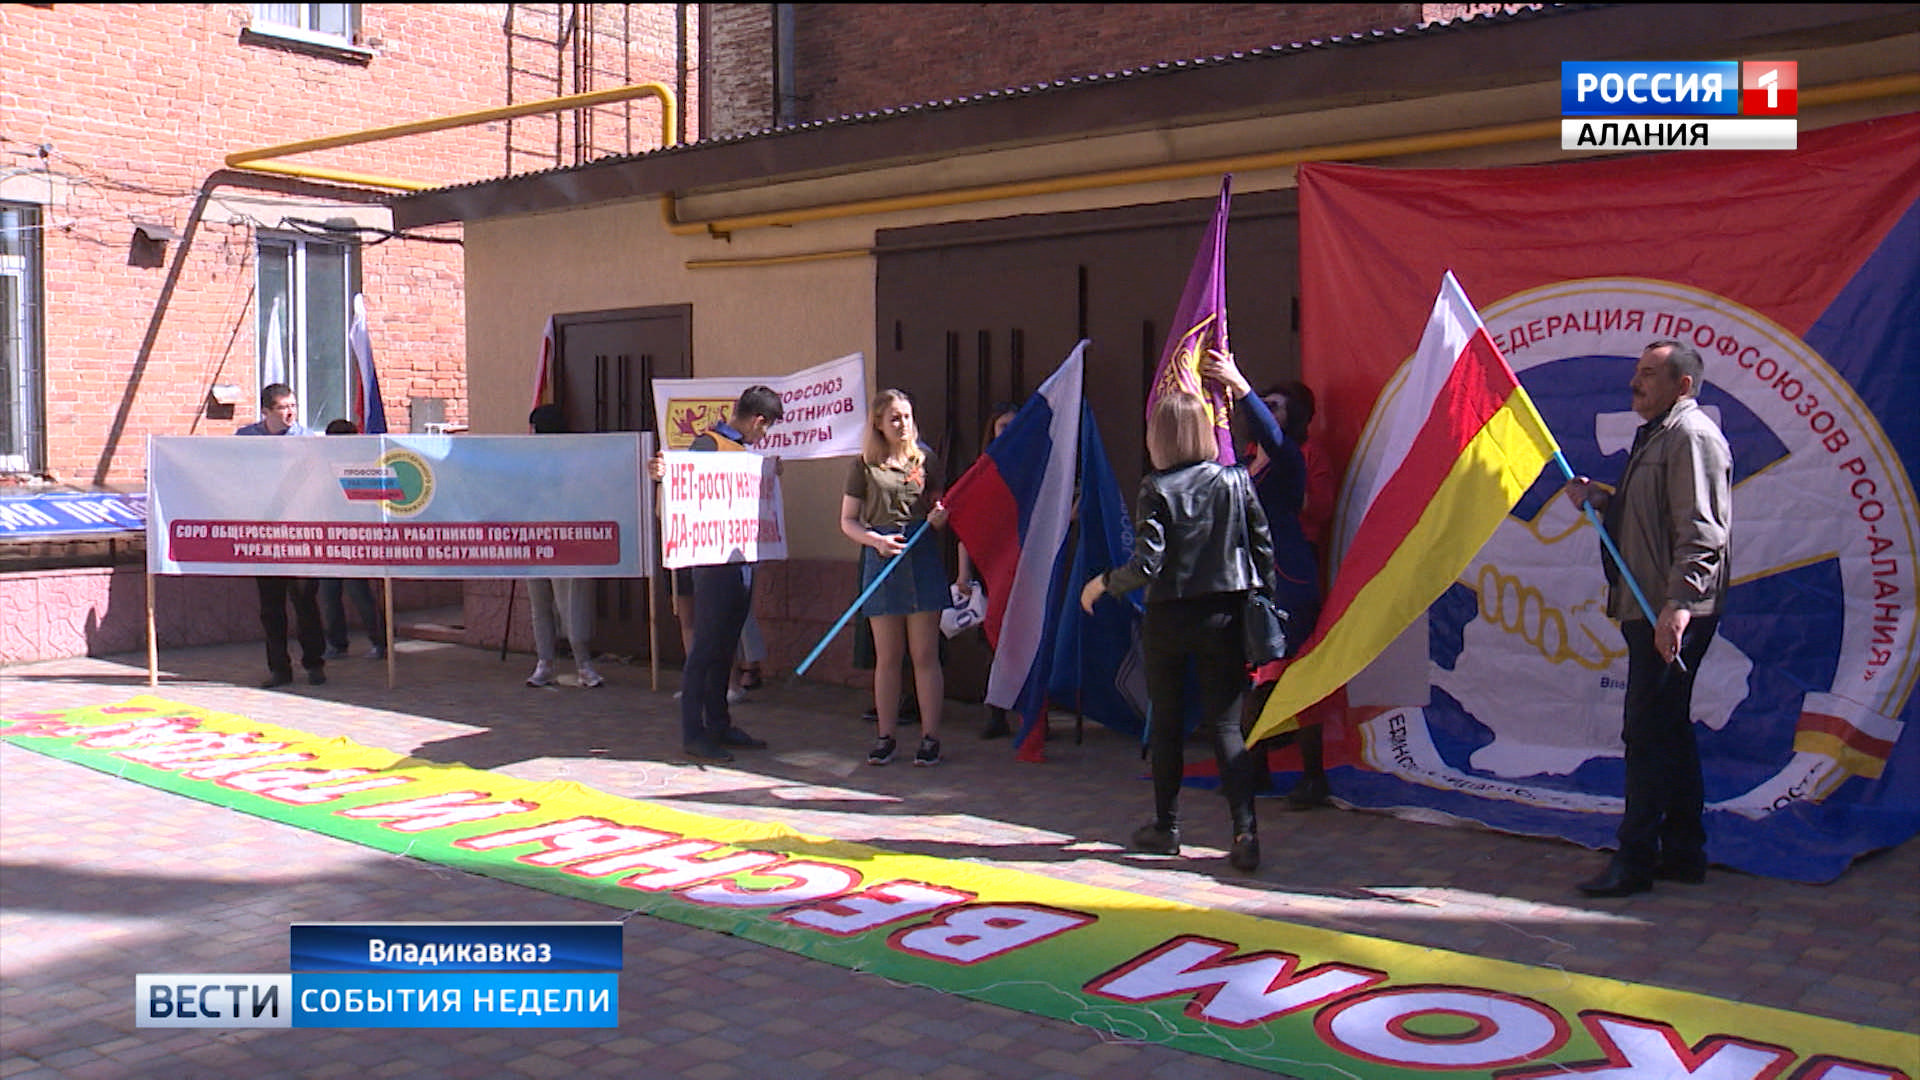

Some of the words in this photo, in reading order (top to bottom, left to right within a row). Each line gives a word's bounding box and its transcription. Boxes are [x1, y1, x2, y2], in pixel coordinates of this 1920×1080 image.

[778, 377, 843, 404] ОФСОЮЗ
[1496, 309, 1645, 355] ЕДЕРАЦИЯ
[1652, 313, 1849, 453] ПРОФСОЮЗОВ
[176, 525, 207, 538] СОРО
[212, 525, 323, 541] ОБЩЕРОССИЙСКОГО
[327, 527, 400, 541] ПРОФСОЮЗА
[404, 527, 483, 541] РАБОТНИКОВ
[488, 527, 613, 542] ГОСУДАРСТВЕННЫХ
[233, 543, 311, 559] УЧРЕЖДЕНИЙ
[314, 545, 323, 557] И
[326, 545, 422, 560] ОБЩЕСТВЕННОГО
[427, 546, 531, 560] ОБСЛУЖИВАНИЯ
[536, 546, 554, 559] РФ
[334, 789, 541, 834] И
[453, 816, 1100, 967] ВЕСНЫ
[1082, 934, 1908, 1080] КОМ
